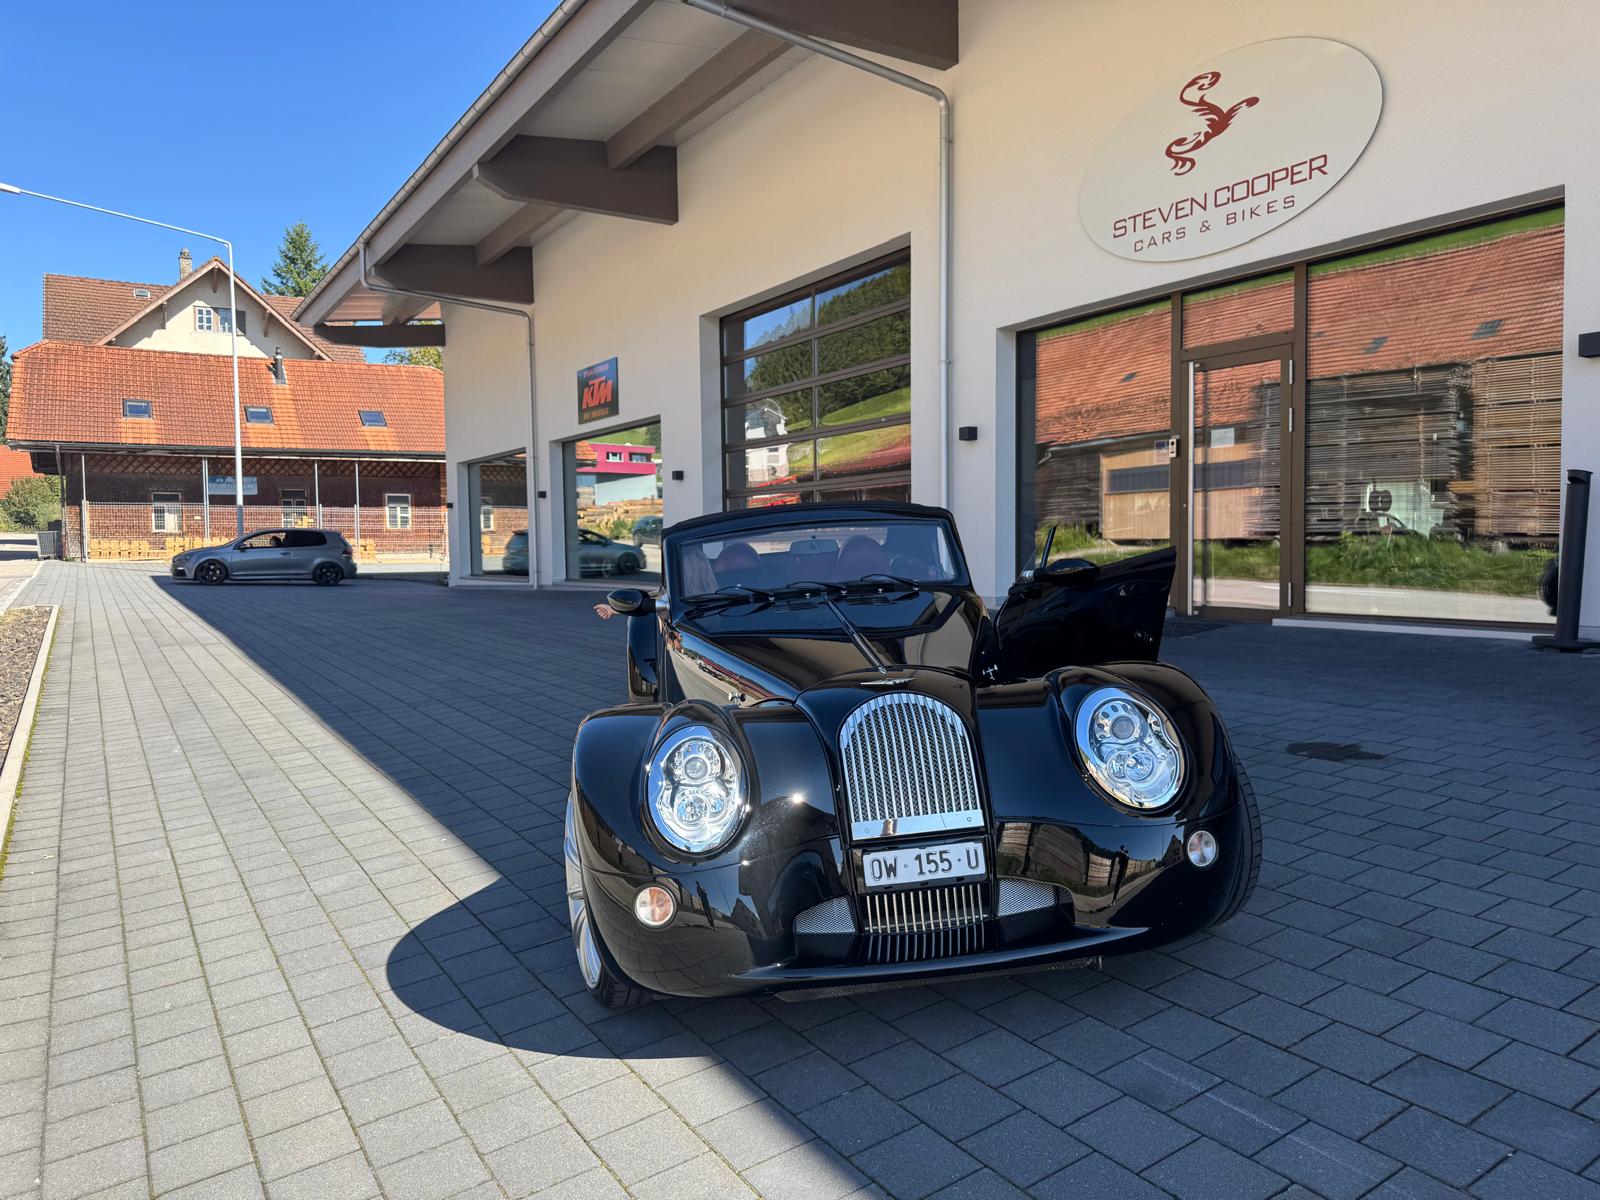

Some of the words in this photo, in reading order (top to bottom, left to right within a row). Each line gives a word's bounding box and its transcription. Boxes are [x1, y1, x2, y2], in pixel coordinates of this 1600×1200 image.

[1112, 192, 1207, 239] STEVEN
[1214, 153, 1329, 209] COOPER
[1133, 226, 1187, 253] CARS
[1199, 219, 1211, 233] &
[1225, 194, 1296, 226] BIKES
[582, 377, 613, 410] KTM
[871, 855, 899, 881] OW
[914, 850, 953, 876] 155
[965, 847, 980, 870] U
